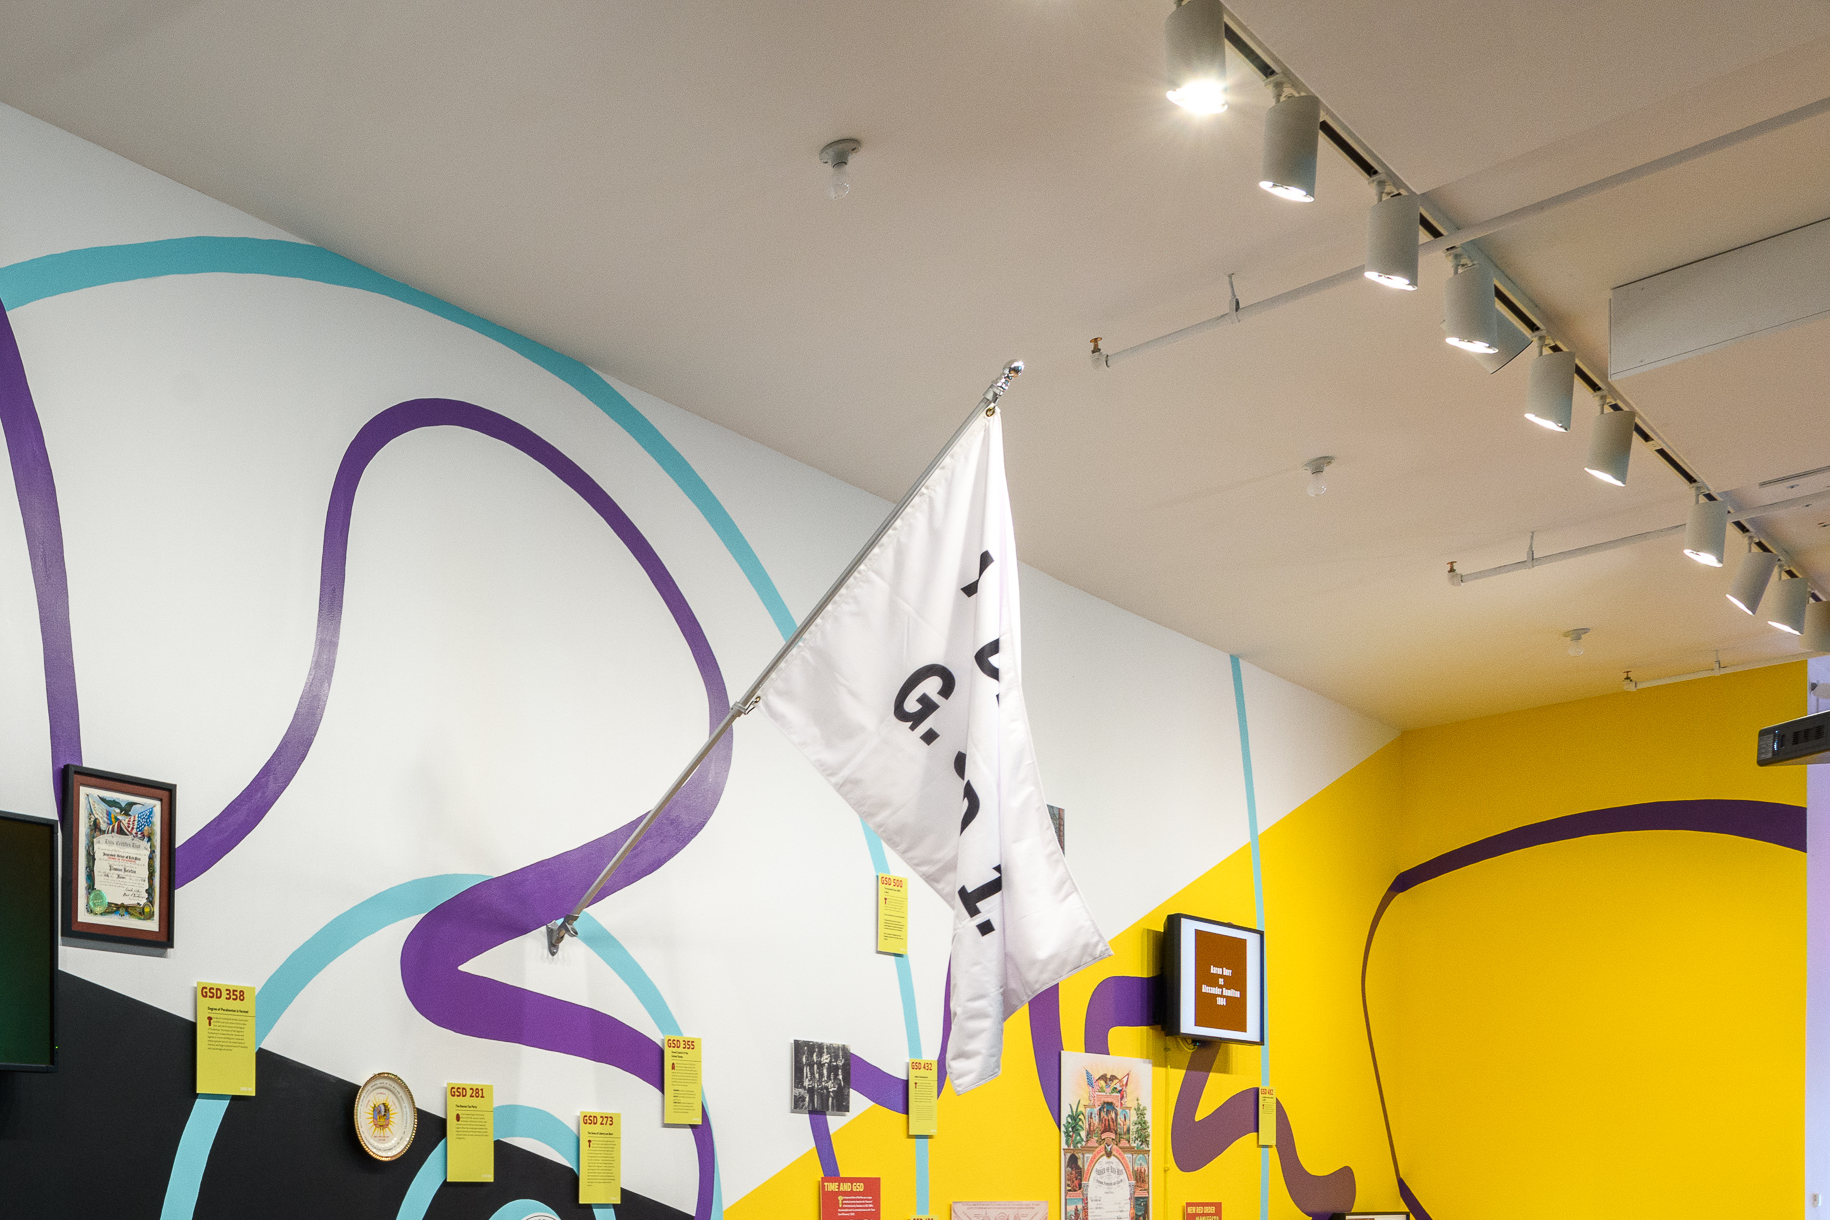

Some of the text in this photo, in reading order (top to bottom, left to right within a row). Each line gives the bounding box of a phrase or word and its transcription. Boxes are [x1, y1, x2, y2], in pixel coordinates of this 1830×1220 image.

[881, 876, 902, 888] GSD 500
[201, 986, 244, 1001] GSD 358
[667, 1039, 695, 1050] GSD 355
[911, 1062, 921, 1070] GSD
[450, 1087, 484, 1098] GSD 281
[583, 1115, 613, 1126] GSD 273
[824, 1182, 864, 1191] TIME AND GSD
